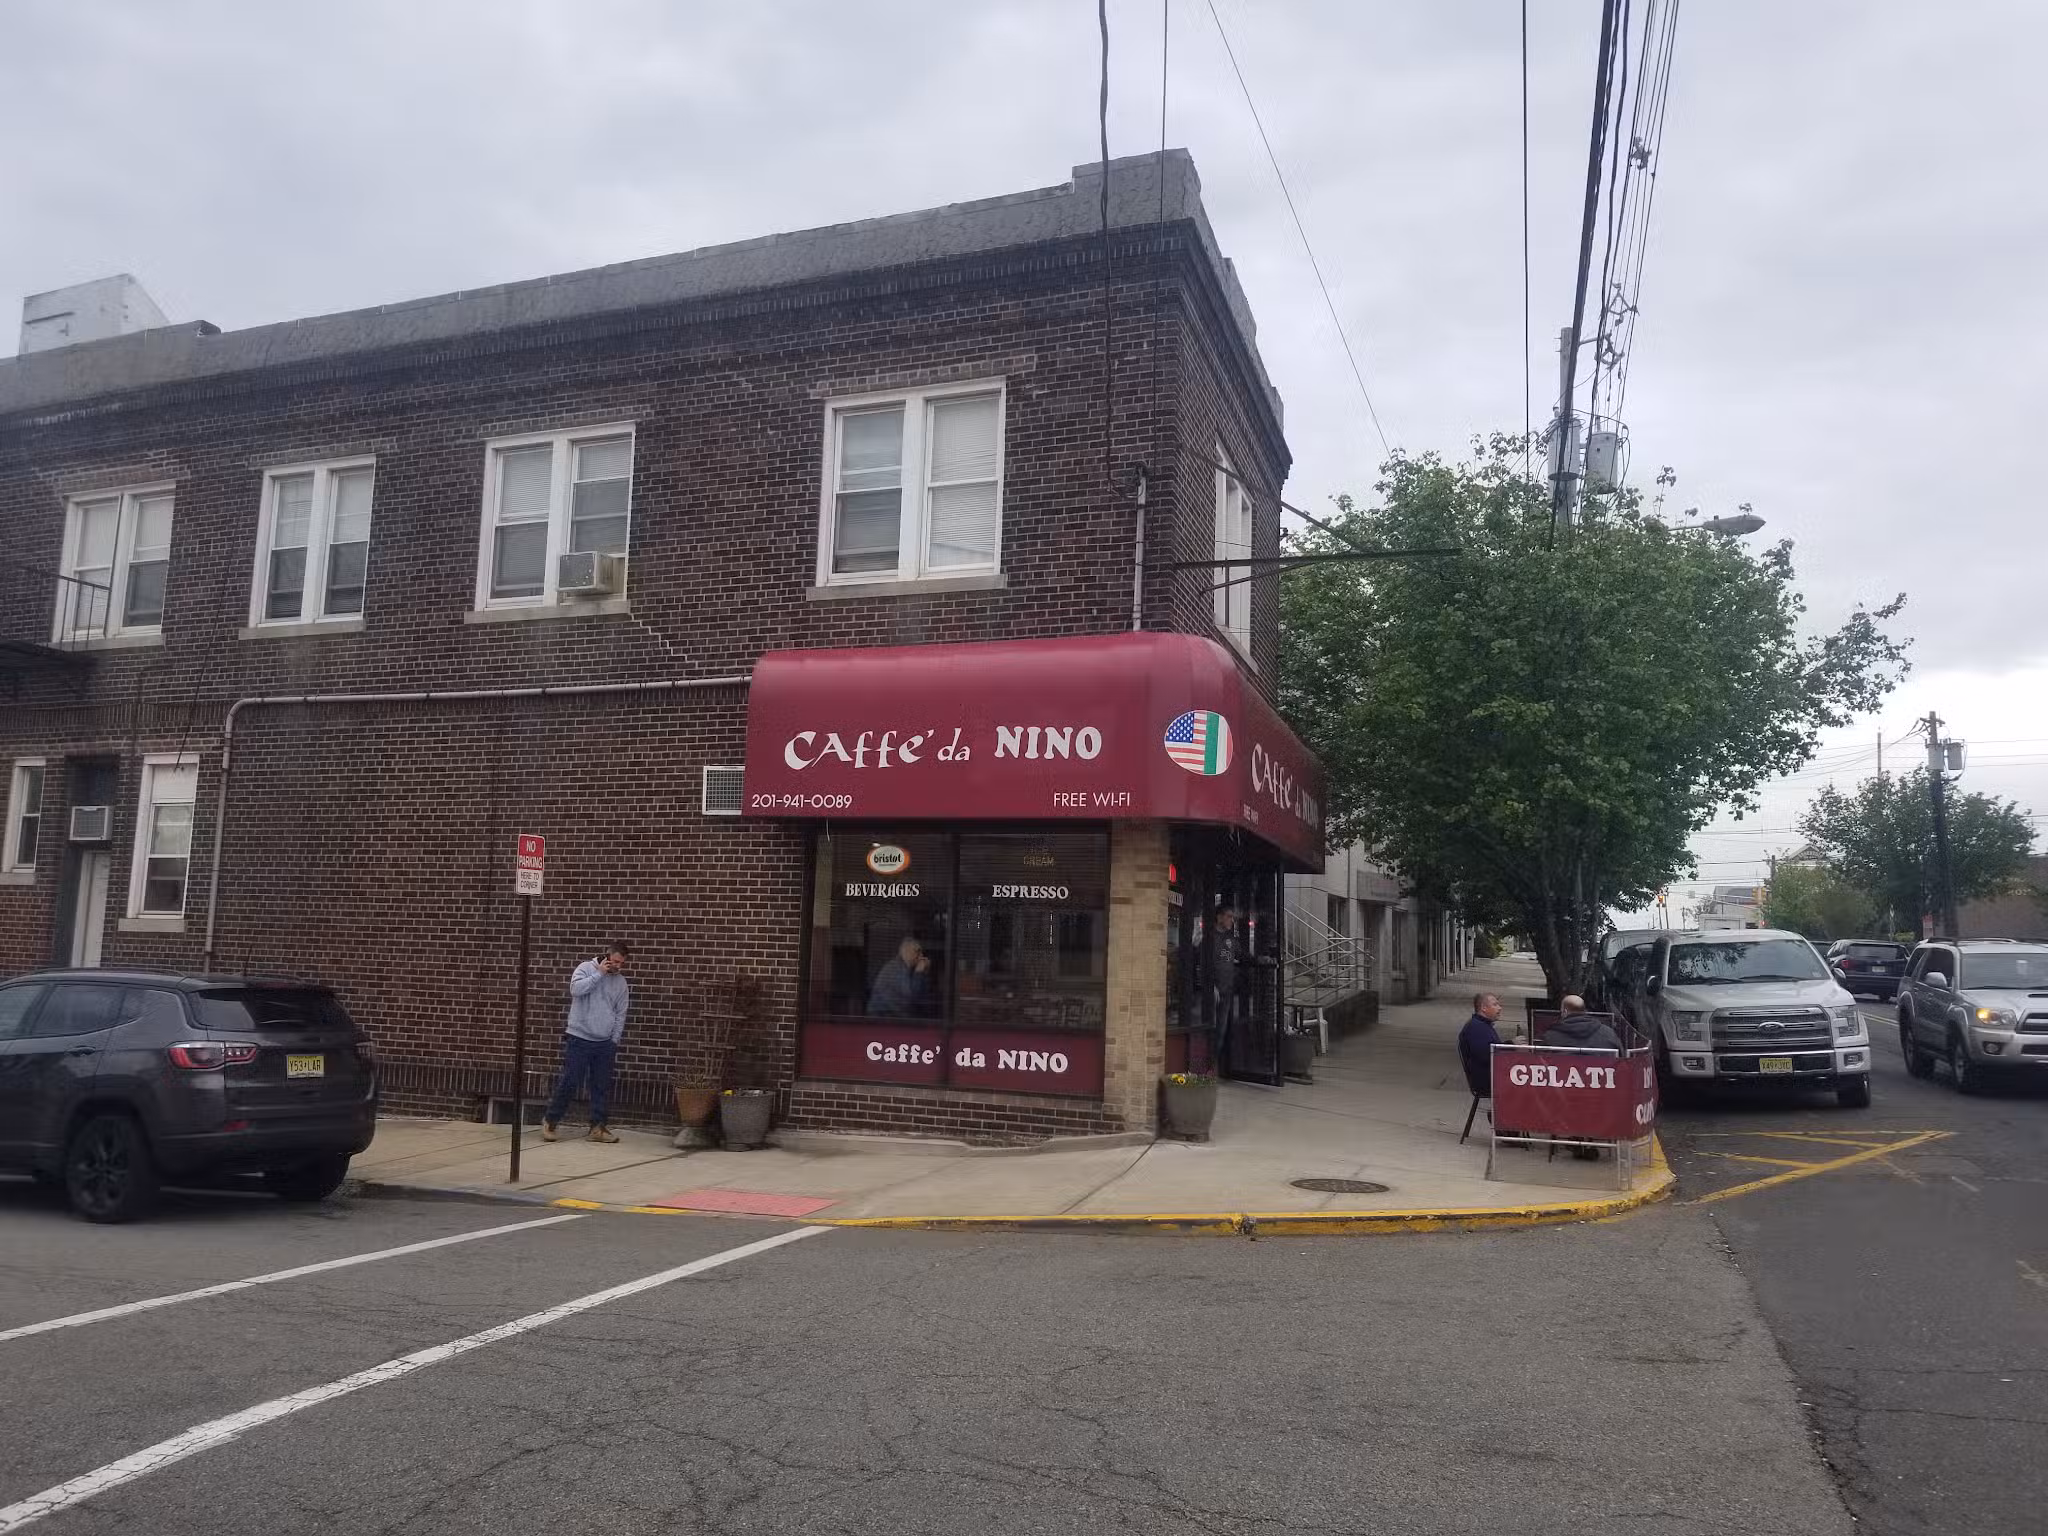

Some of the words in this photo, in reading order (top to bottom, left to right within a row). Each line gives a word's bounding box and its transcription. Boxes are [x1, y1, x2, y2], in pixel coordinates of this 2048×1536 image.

[937, 728, 971, 761] da
[994, 726, 1103, 760] NINO
[751, 793, 853, 809] 201-941-0089
[1053, 792, 1087, 807] FREE
[1092, 792, 1130, 807] WI-FI
[526, 840, 536, 852] NO
[519, 855, 542, 868] PARKING
[873, 854, 903, 864] bristol
[533, 872, 540, 881] TO
[520, 881, 538, 889] CORNER
[845, 883, 920, 898] BEVERAGES
[992, 884, 1069, 899] ESPRESSO
[955, 1047, 986, 1067] da
[997, 1049, 1069, 1073] NINO
[1509, 1064, 1616, 1089] GELATI
